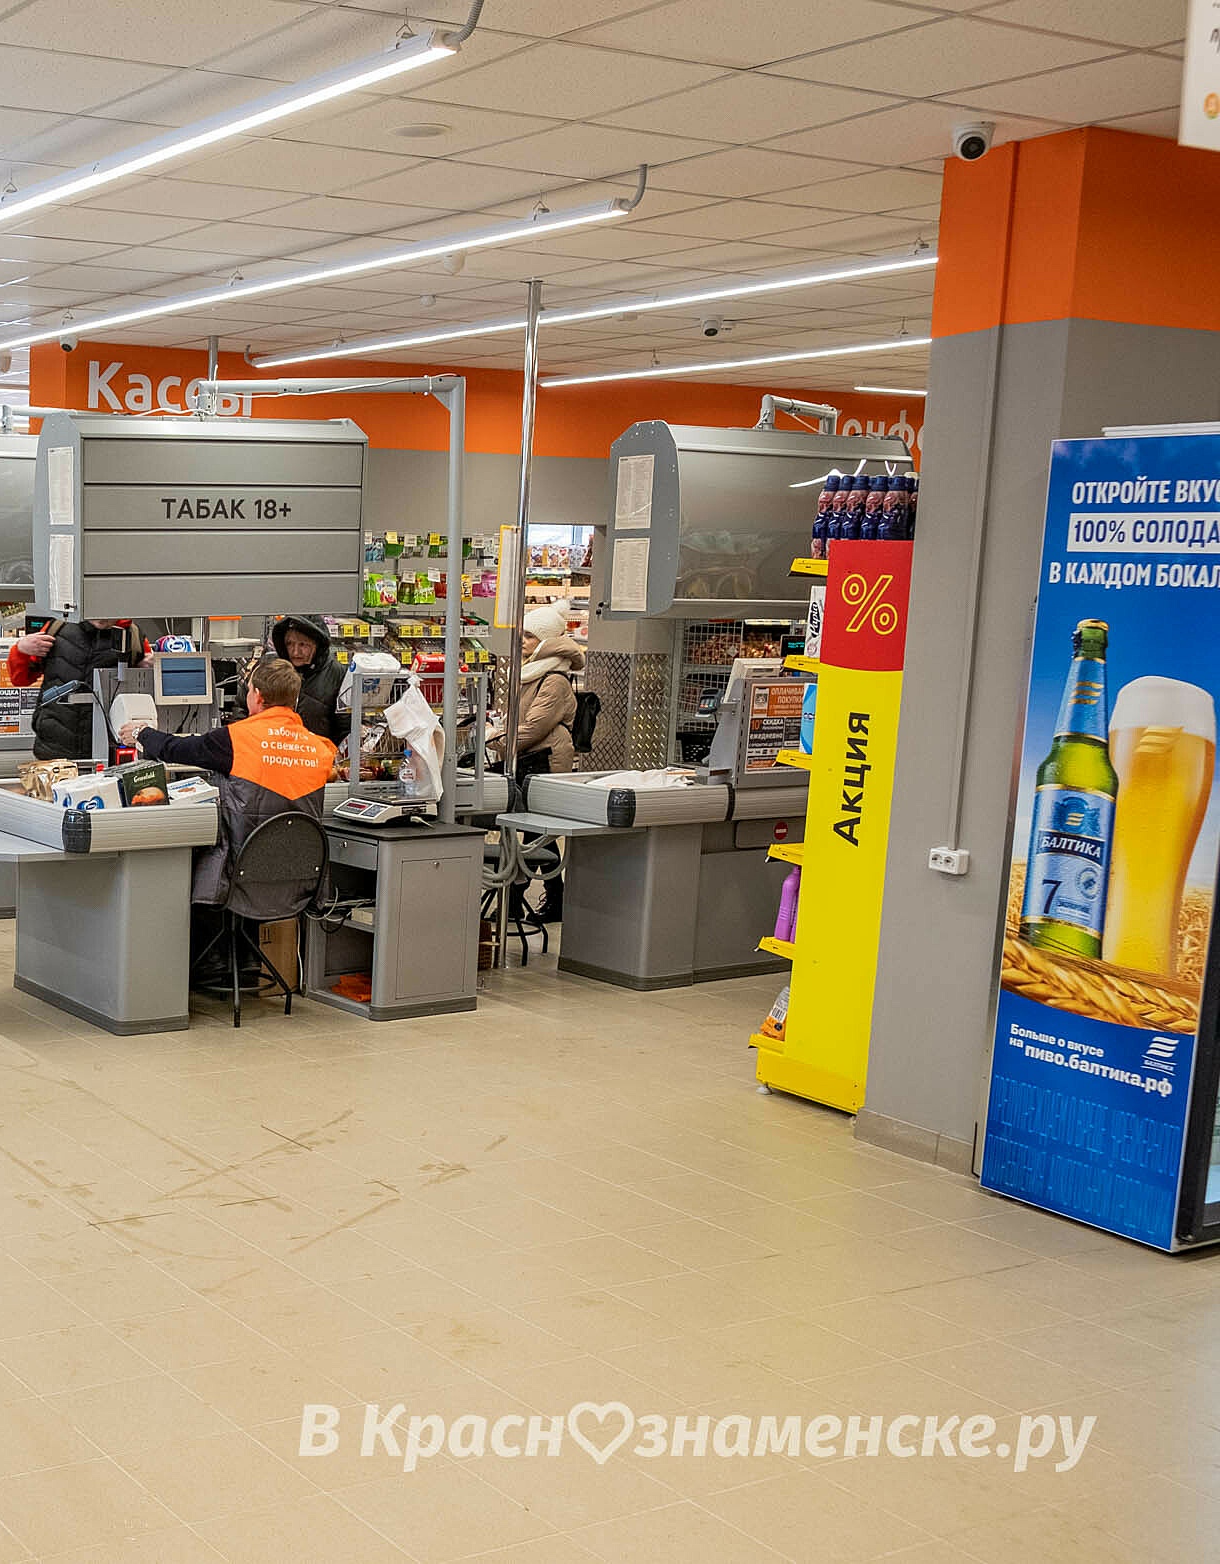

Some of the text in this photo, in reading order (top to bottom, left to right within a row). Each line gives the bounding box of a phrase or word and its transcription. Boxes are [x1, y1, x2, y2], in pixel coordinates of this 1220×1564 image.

[1072, 475, 1171, 504] ОТКРОЙТЕ
[161, 498, 292, 520] ТАБАК 18+
[1074, 519, 1220, 548] 100% СОЛОДА
[1048, 561, 1062, 584] В
[1064, 561, 1153, 590] КАЖДОМ
[262, 755, 319, 768] продуктов!
[270, 741, 317, 753] свежести
[833, 712, 871, 847] Акция
[1041, 836, 1101, 858] БАЛТИКА
[1042, 879, 1062, 915] 7
[1010, 1023, 1105, 1058] Больше о вкусе
[1009, 1037, 1174, 1098] на пиво.балтика.рф
